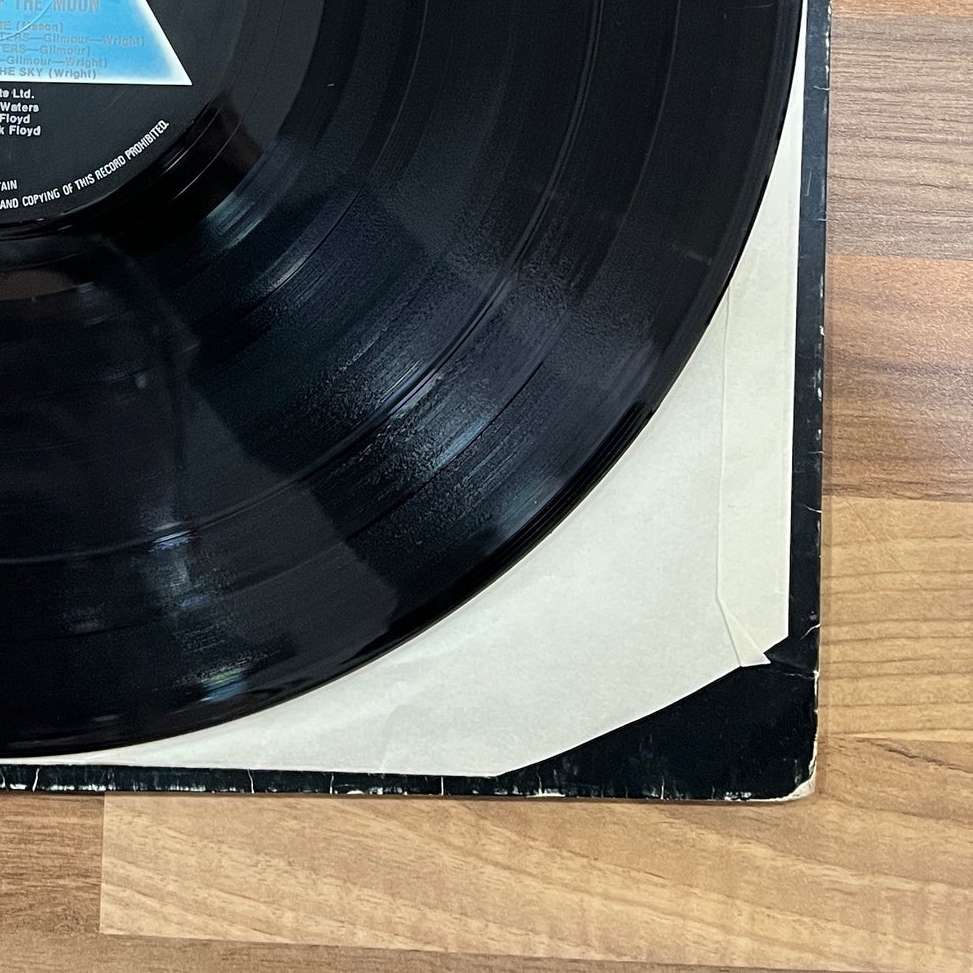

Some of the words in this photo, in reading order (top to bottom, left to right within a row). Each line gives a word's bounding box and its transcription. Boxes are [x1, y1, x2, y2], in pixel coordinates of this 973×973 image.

[19, 67, 44, 77] SKY
[49, 68, 97, 80] (Wright)
[12, 88, 35, 99] Ltd.
[0, 102, 39, 112] Waters
[0, 114, 31, 124] Floyd
[9, 125, 41, 136] Floyd
[0, 198, 19, 210] AND
[22, 188, 60, 207] COPYING
[62, 184, 73, 196] OF
[74, 174, 95, 190] THIS
[95, 155, 126, 180] RECORD
[124, 120, 170, 160] PROHIBITED.
